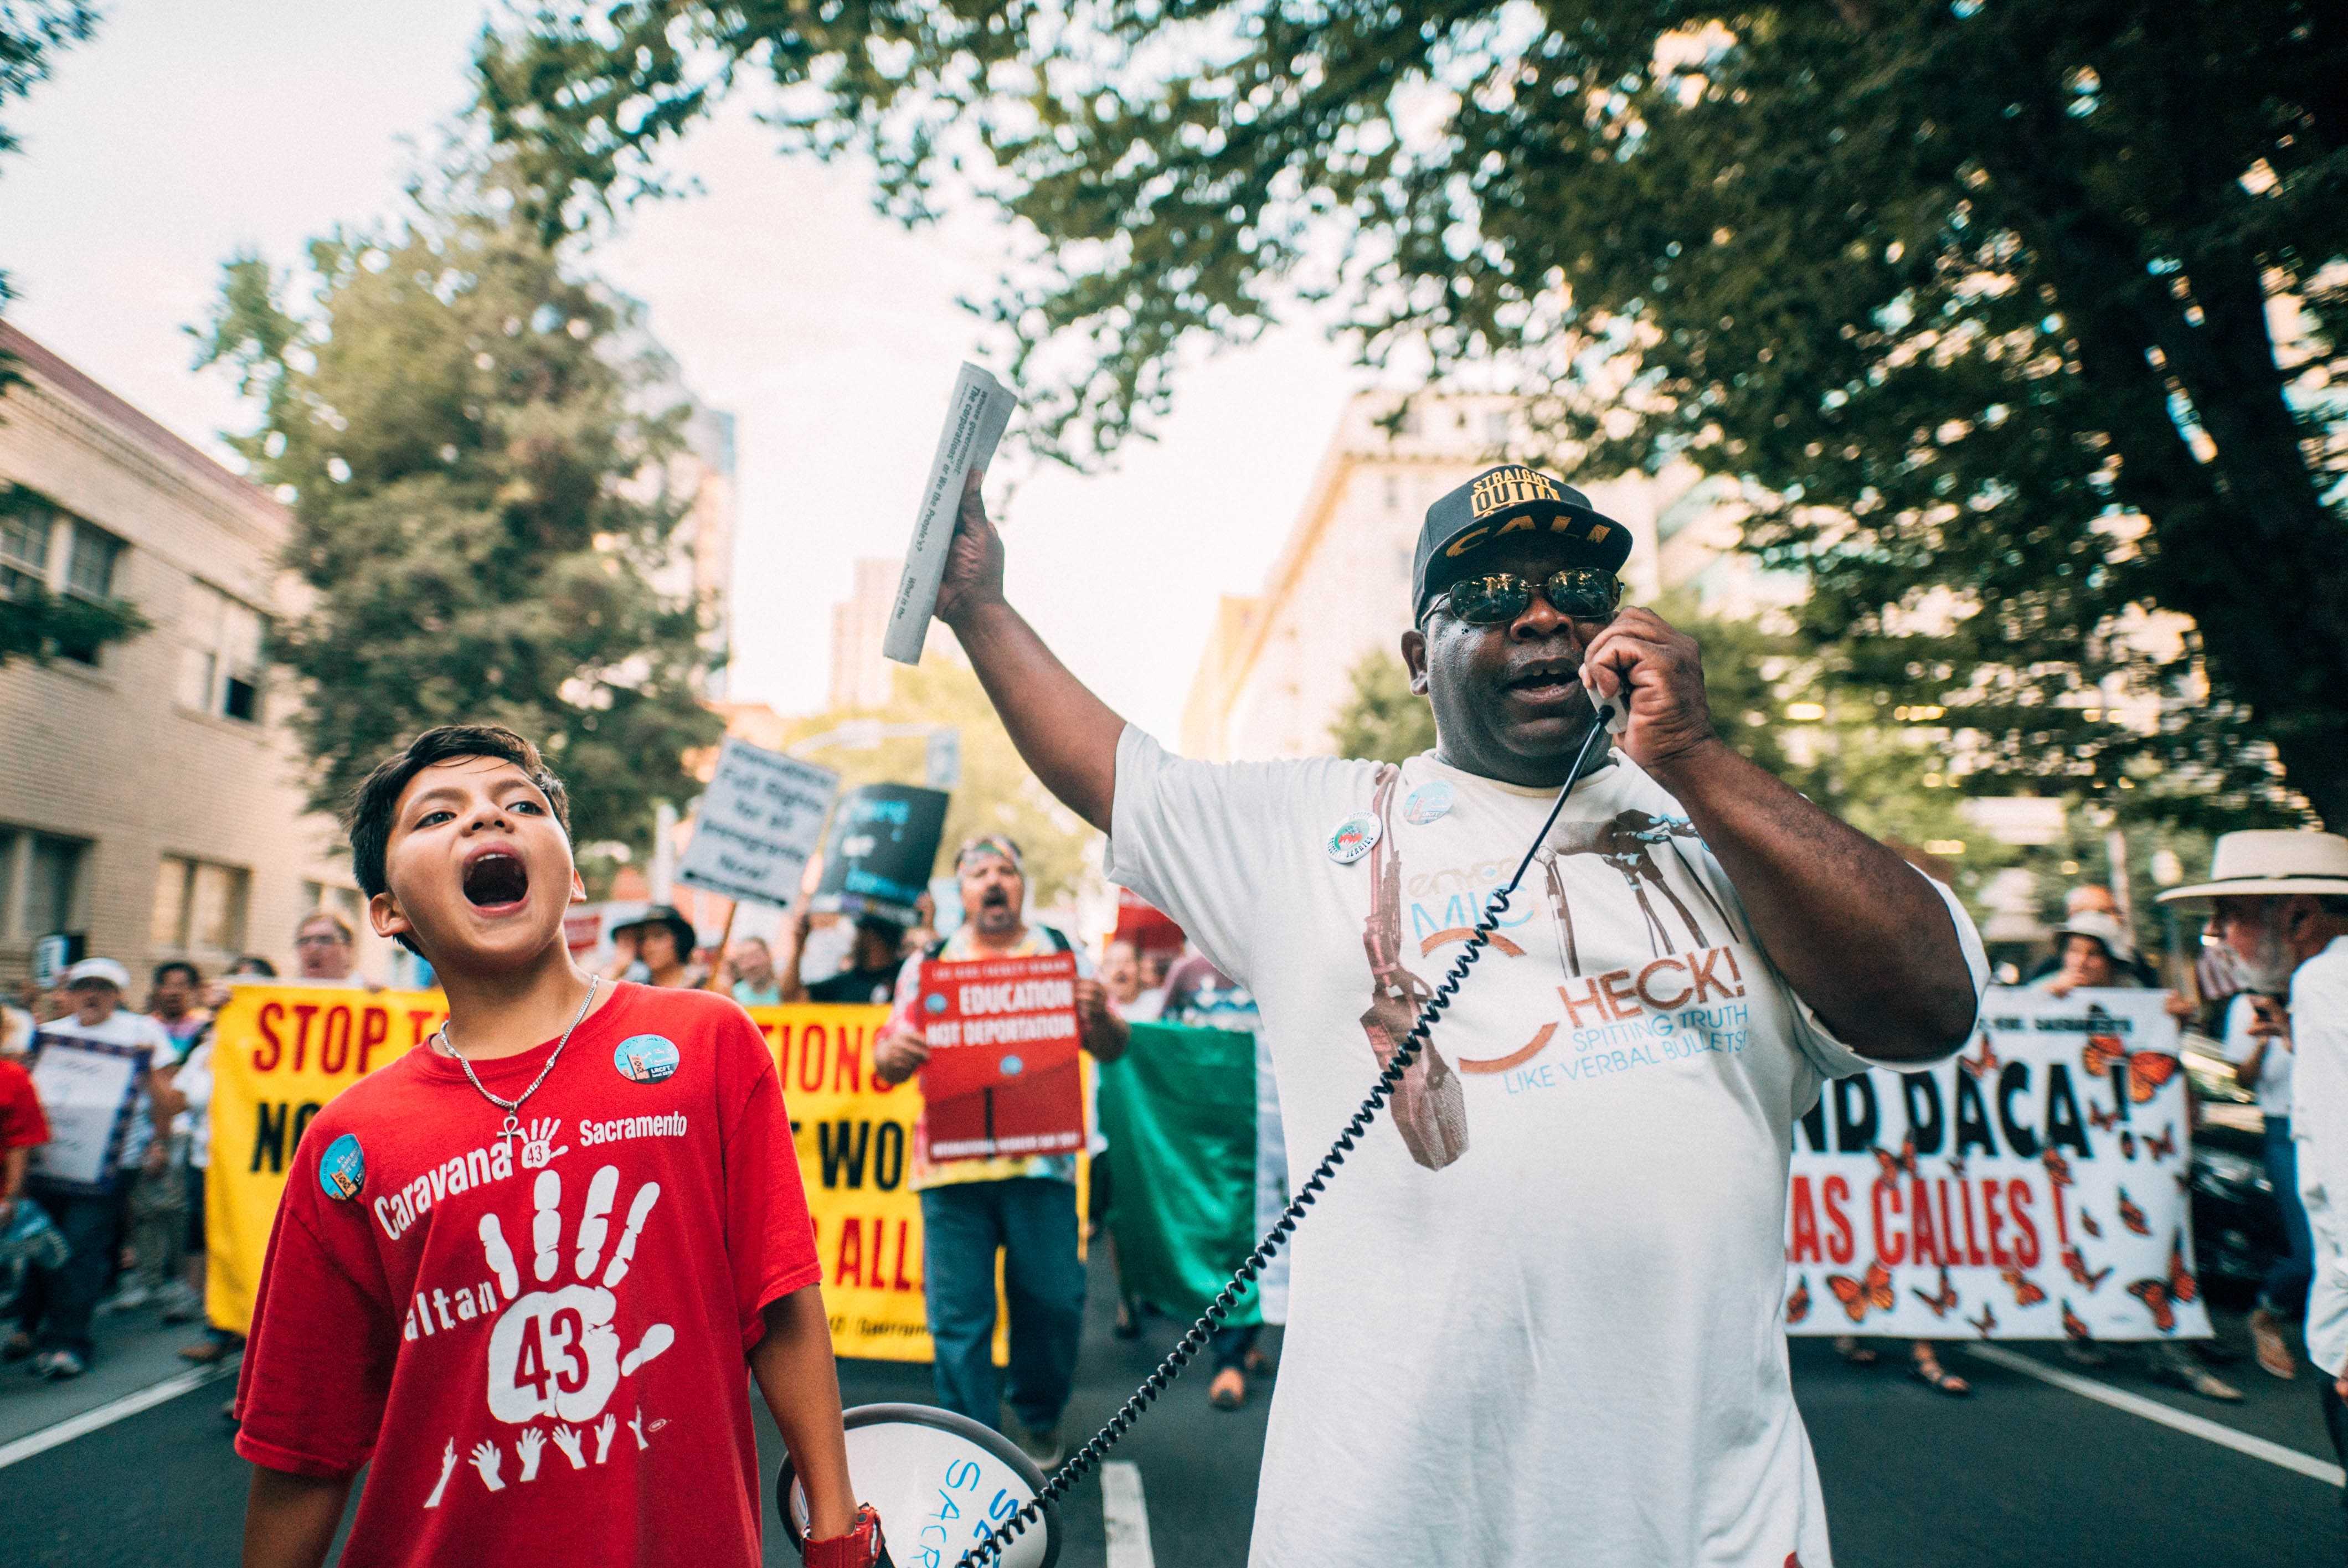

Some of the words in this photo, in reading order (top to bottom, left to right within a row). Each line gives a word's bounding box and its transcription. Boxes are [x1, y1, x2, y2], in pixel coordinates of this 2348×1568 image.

[968, 385, 981, 403] The
[973, 390, 988, 420] Whose
[935, 476, 948, 491] We
[942, 463, 950, 474] or
[1473, 468, 1551, 493] STRAIGHT
[929, 492, 941, 507] the
[1471, 480, 1560, 515] OUTTA
[914, 508, 935, 552] People's?
[1445, 515, 1611, 558] CALI
[900, 597, 908, 606] is
[903, 577, 916, 598] What
[895, 607, 905, 620] the
[1411, 884, 1533, 941] MIC
[959, 979, 1074, 1016] EDUCATION
[253, 1002, 387, 1074] STOP
[925, 1021, 961, 1049] NOT
[962, 1013, 1076, 1047] DEPORTATION
[1573, 1014, 1674, 1053] SPITTING
[1679, 1004, 1748, 1030] TRUTH
[1503, 1064, 1556, 1095] LIKE
[1561, 1046, 1662, 1080] VERBAL
[579, 1111, 687, 1146] Sacramento
[527, 1144, 543, 1163] 43
[374, 1140, 513, 1241] Caravana
[1786, 1174, 1855, 1266] AS
[835, 1218, 911, 1291] ALL
[514, 1307, 589, 1401] 43
